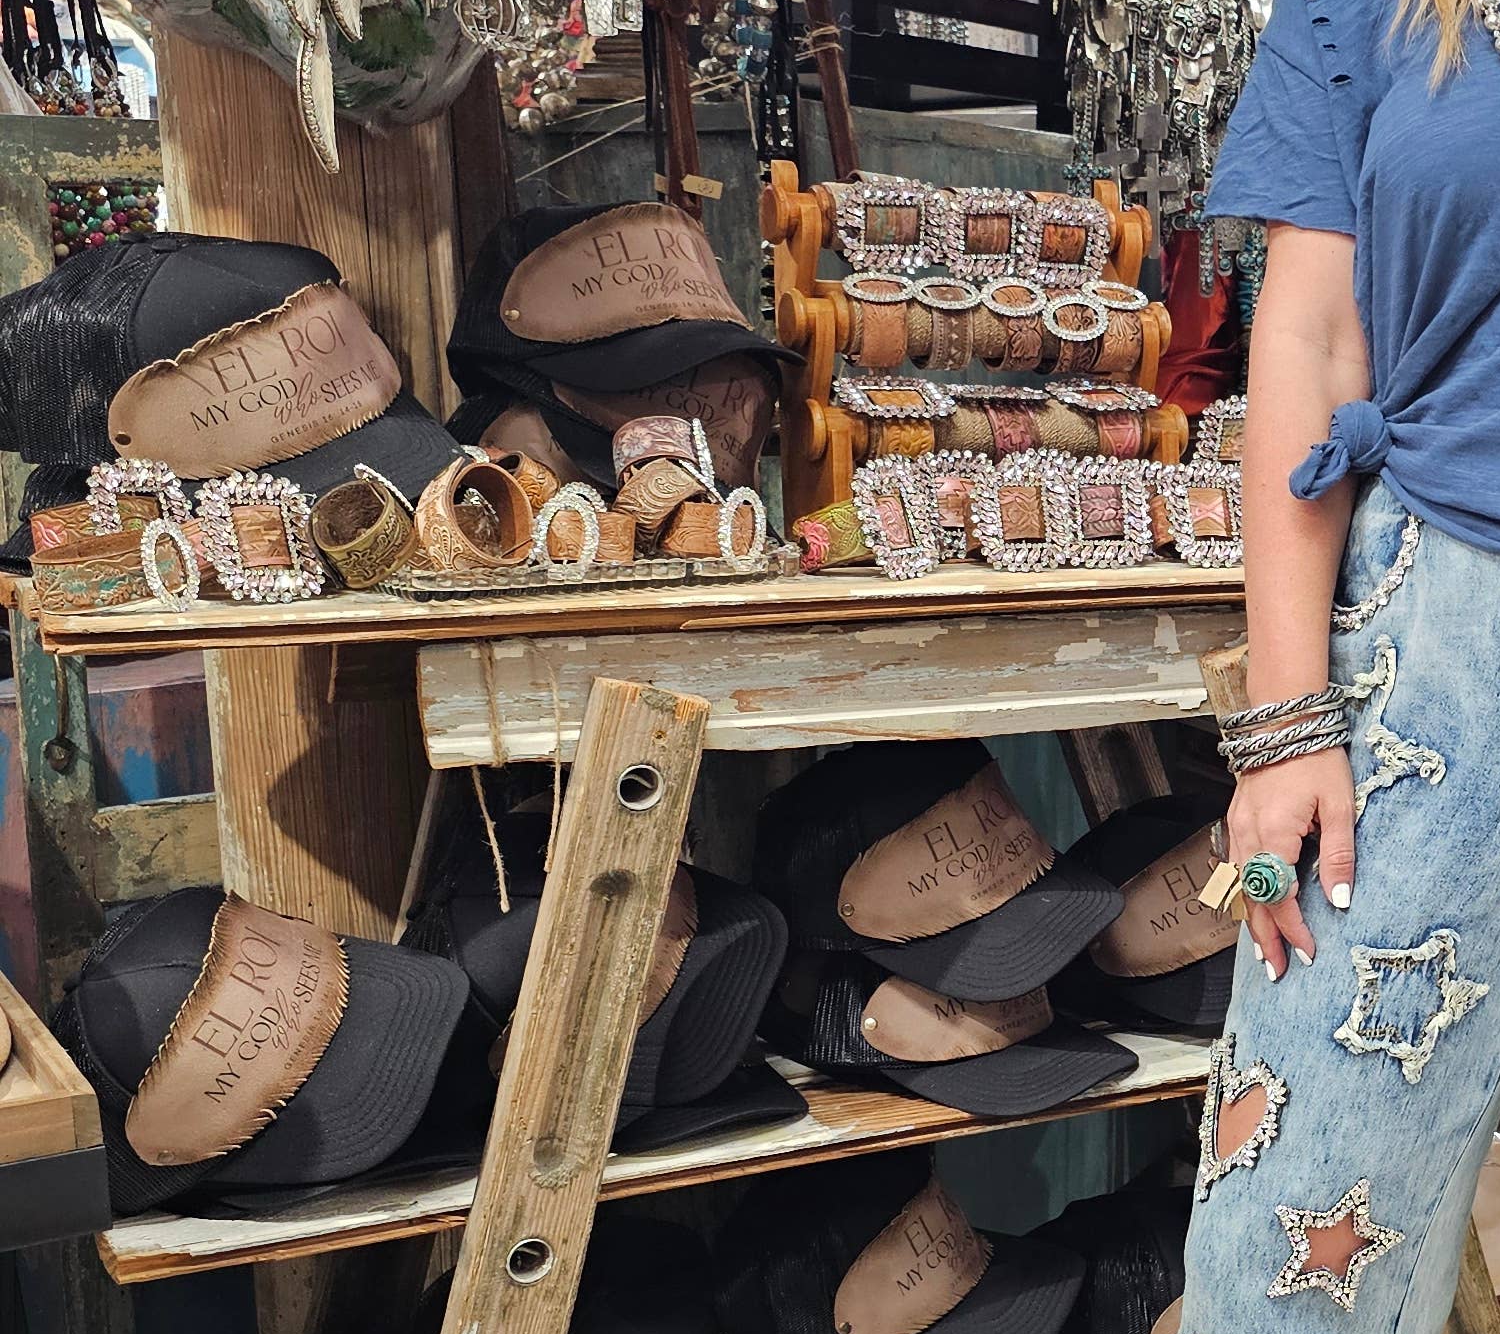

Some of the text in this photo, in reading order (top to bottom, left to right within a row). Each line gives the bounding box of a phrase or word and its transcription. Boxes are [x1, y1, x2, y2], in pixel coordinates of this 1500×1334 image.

[592, 231, 648, 268] EL
[571, 274, 603, 300] MY
[612, 263, 664, 286] GOD
[208, 310, 347, 394] EL ROI
[190, 359, 382, 432] MY GOD who SEES ME
[665, 390, 715, 423] GOD
[270, 419, 320, 444] GENESIS
[923, 820, 975, 864] EL
[907, 868, 939, 897] MY
[945, 843, 990, 878] GOD
[1161, 863, 1206, 903] EL
[1150, 907, 1180, 936] MY
[191, 926, 281, 1059] EL ROI
[934, 997, 967, 1021] MY
[203, 1062, 241, 1103] MY
[237, 1006, 281, 1061] GOD
[293, 959, 321, 1003] SEES
[904, 1214, 944, 1258] EL
[896, 1262, 924, 1297] MY
